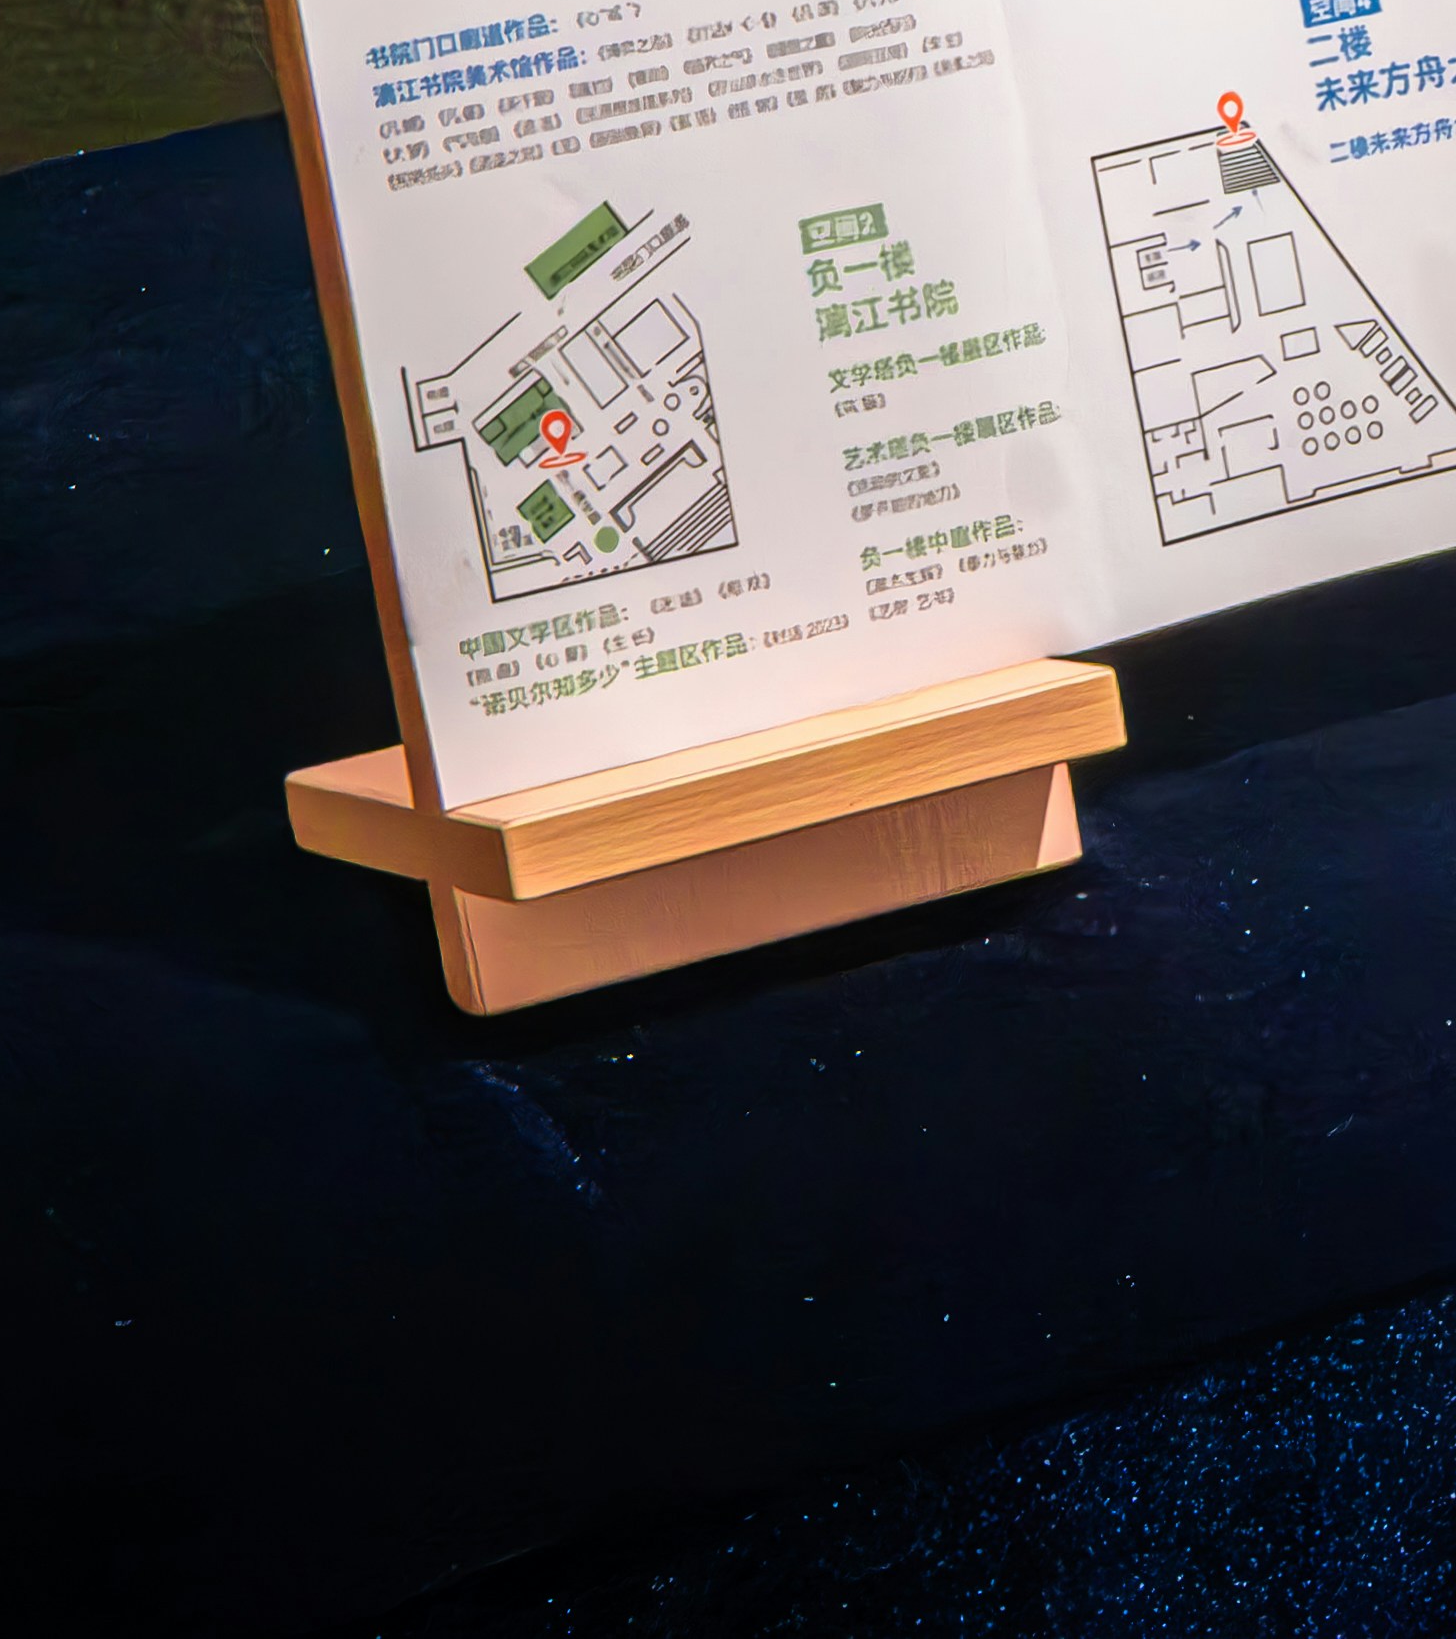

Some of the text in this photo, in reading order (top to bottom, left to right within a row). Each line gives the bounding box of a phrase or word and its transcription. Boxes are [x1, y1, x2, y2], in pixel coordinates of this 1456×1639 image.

[1306, 24, 1373, 68] 二楼
[806, 240, 915, 297] 负一楼
[815, 278, 959, 343] 漓江书院
